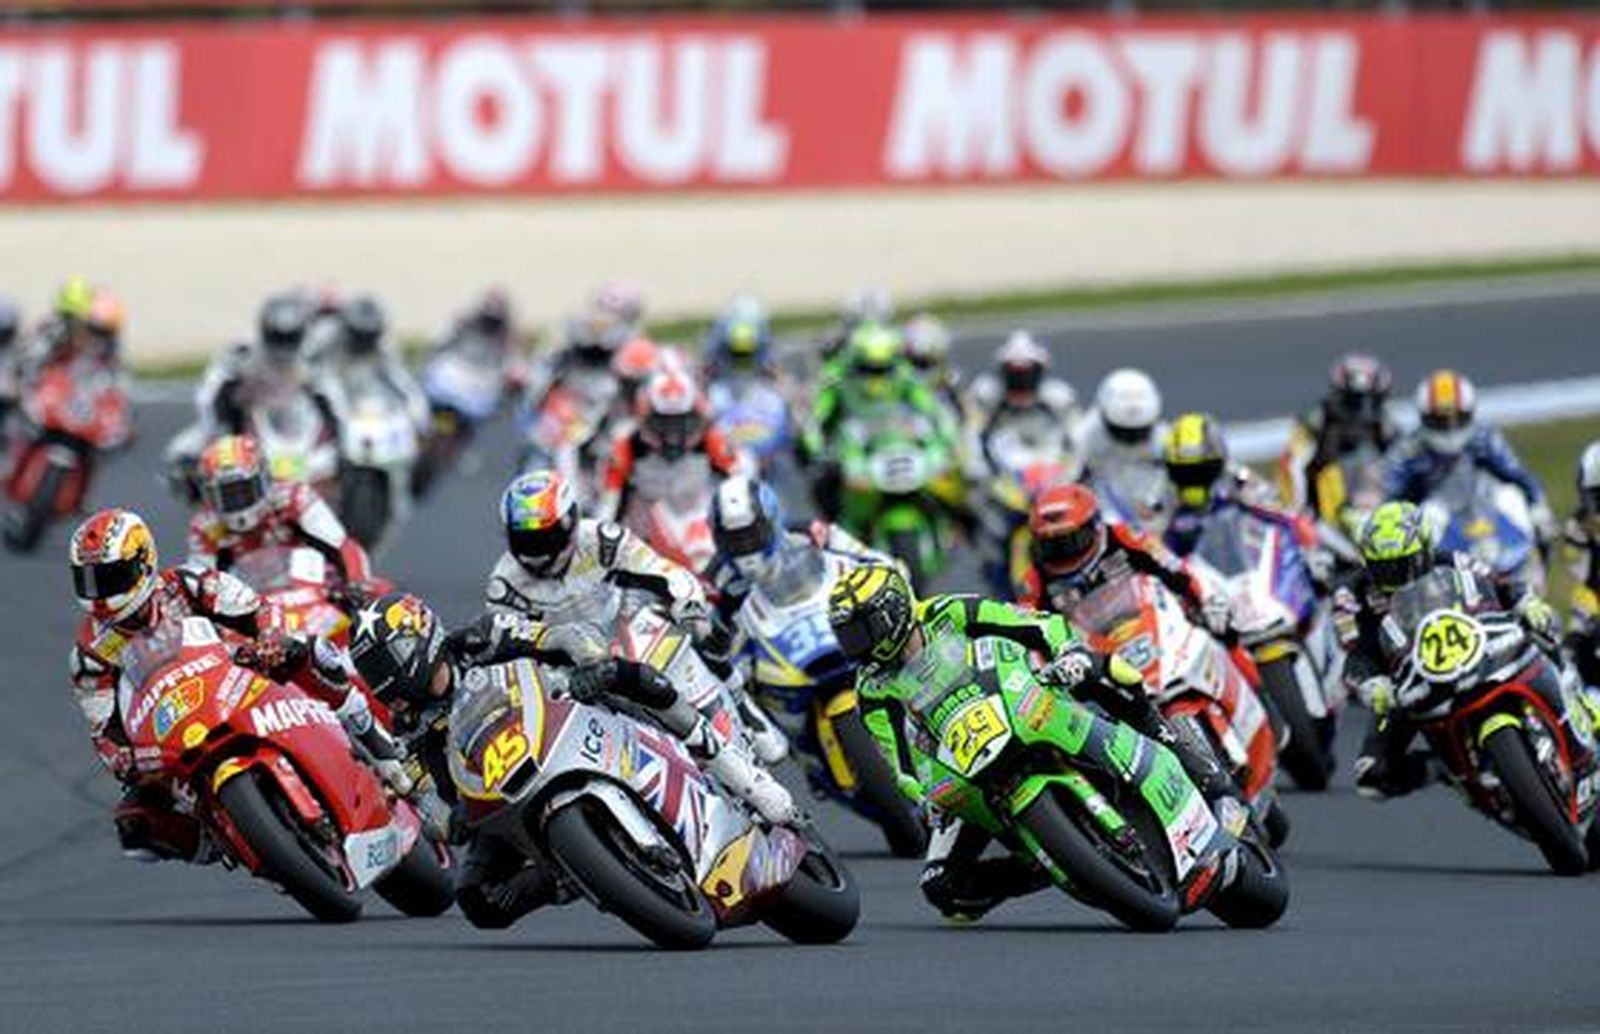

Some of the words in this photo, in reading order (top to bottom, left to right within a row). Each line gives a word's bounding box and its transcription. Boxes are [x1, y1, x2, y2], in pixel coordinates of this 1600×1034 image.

[0, 38, 205, 194] UL
[298, 34, 788, 190] MOTUL
[882, 28, 1377, 178] MOTUL
[1460, 28, 1600, 174] M
[1425, 623, 1469, 667] 24
[483, 722, 529, 791] 45
[944, 702, 1009, 774] 29
